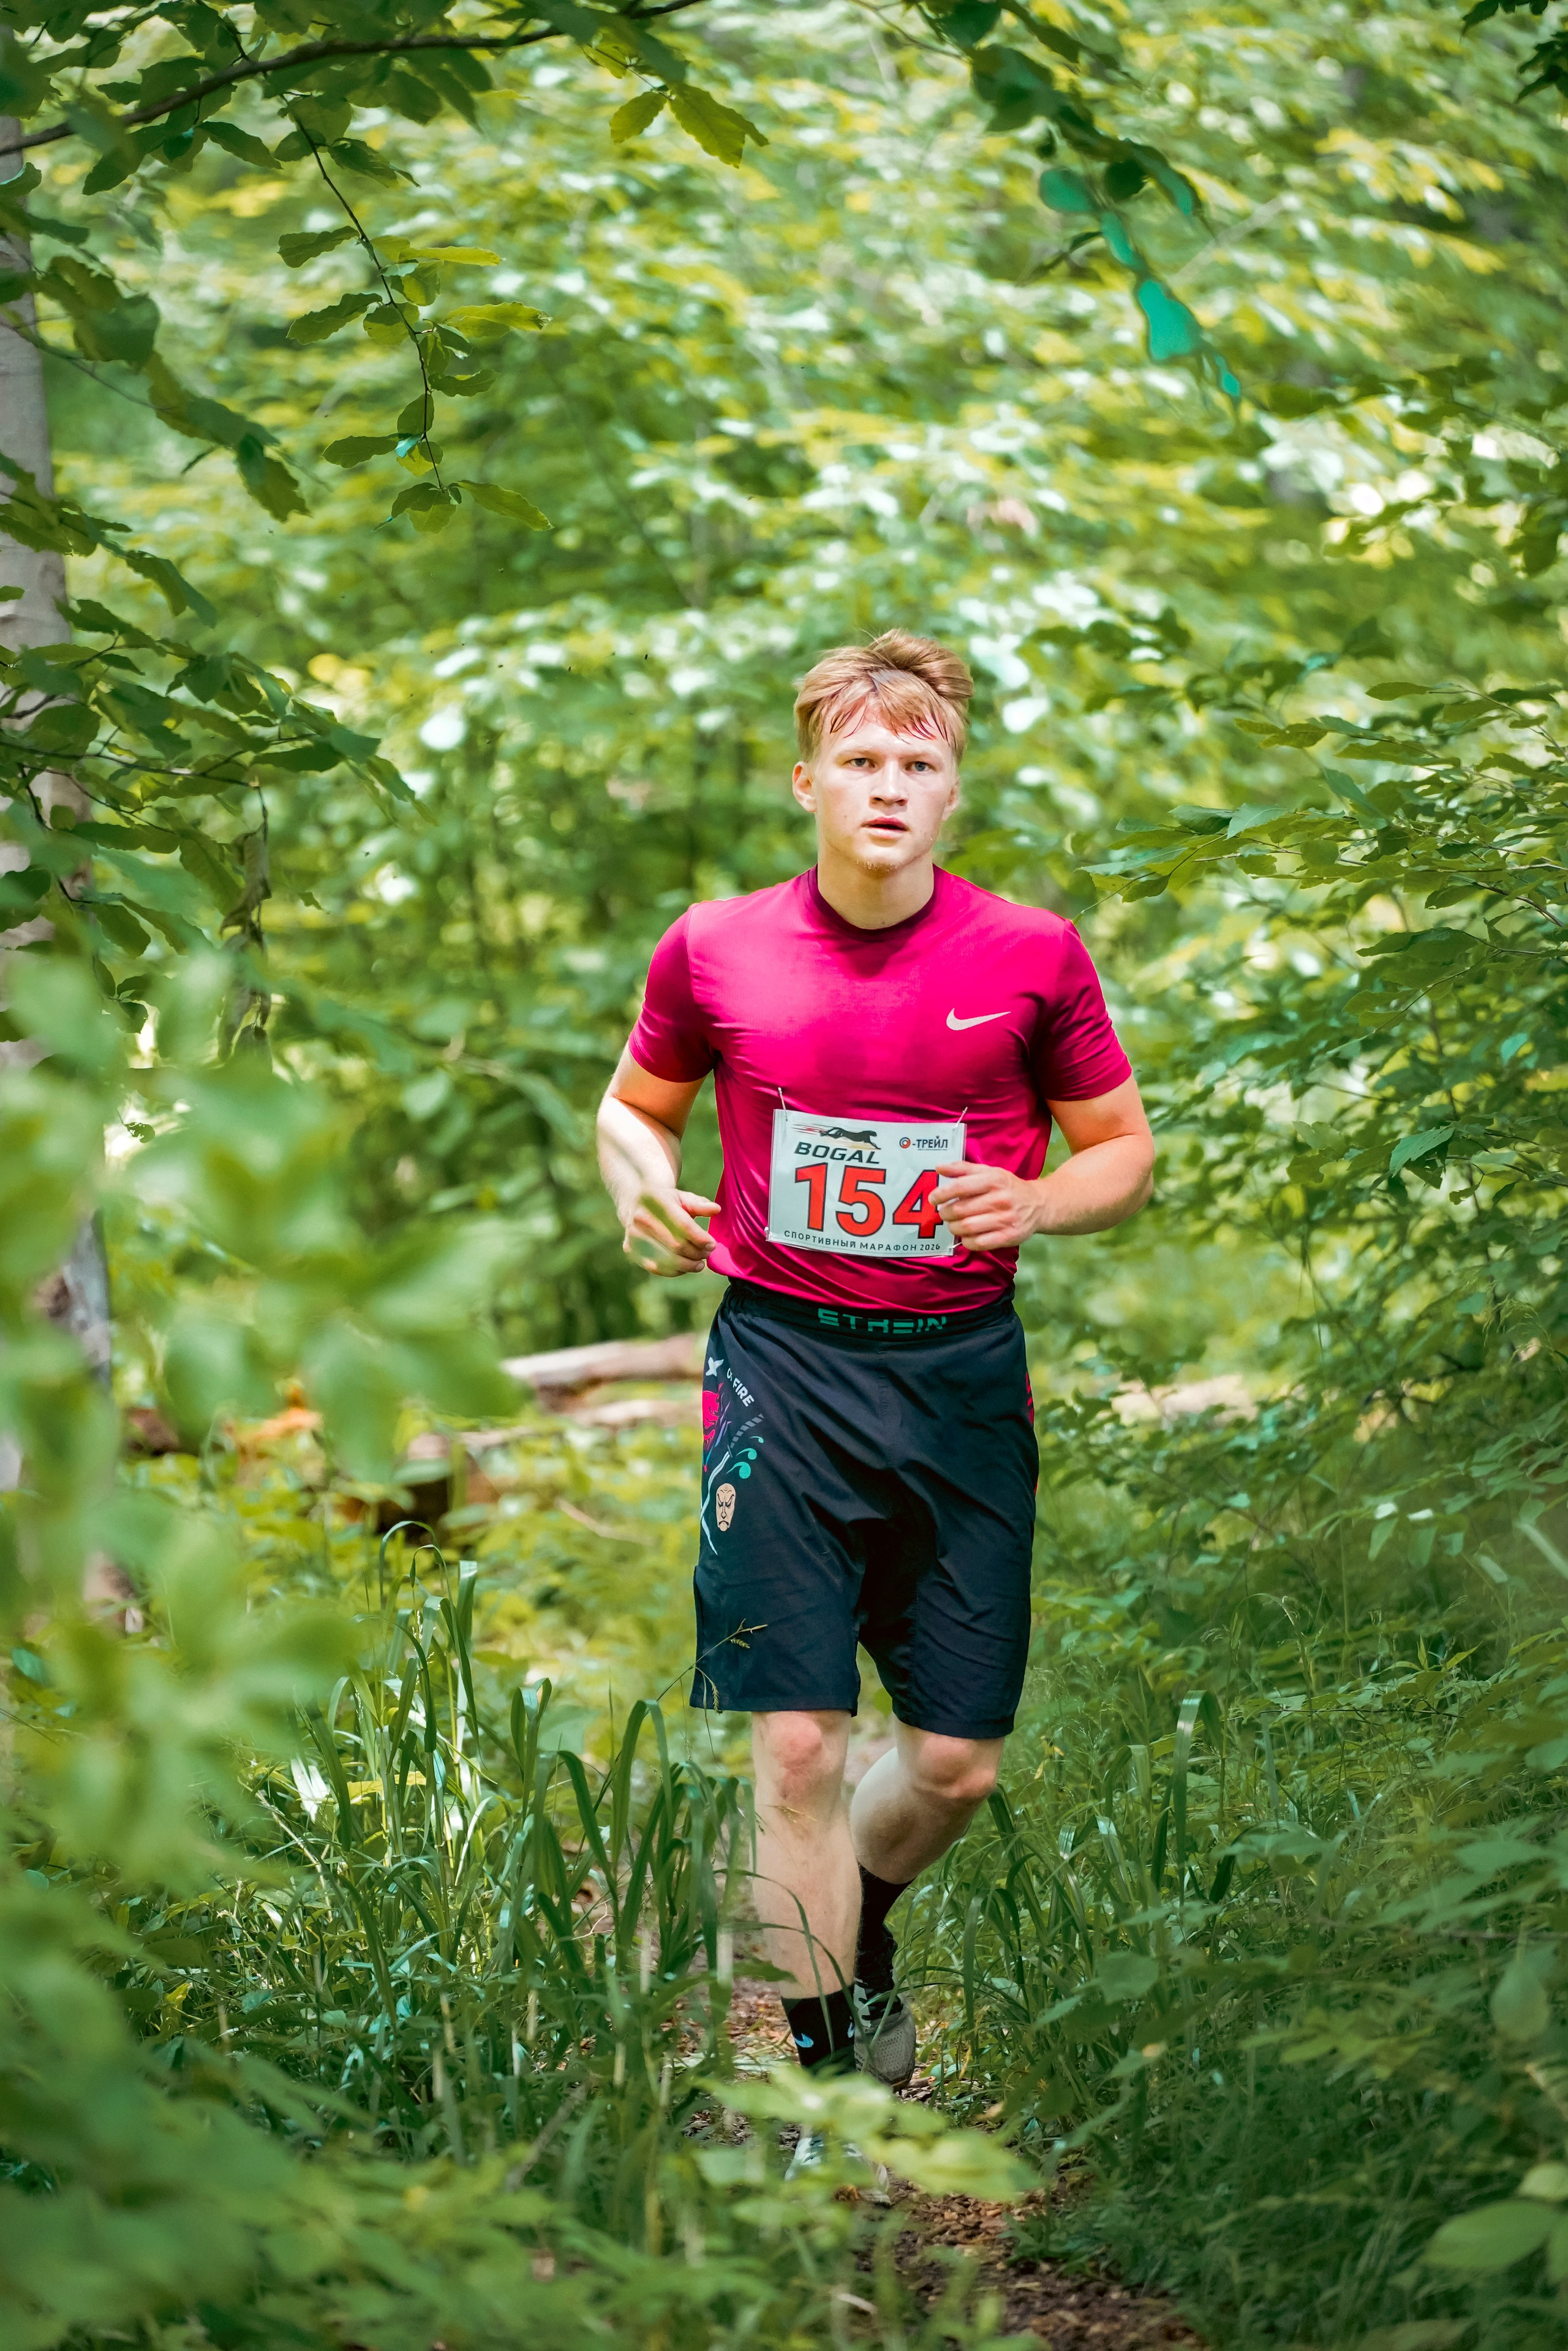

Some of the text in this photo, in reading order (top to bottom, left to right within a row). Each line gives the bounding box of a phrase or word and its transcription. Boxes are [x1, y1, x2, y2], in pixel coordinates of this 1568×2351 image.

[794, 1141, 880, 1164] BOGAL
[794, 1162, 944, 1239] 154
[784, 1230, 856, 1248] СПОРТИВНЫЙ
[859, 1242, 917, 1251] МАРАФОН
[733, 1377, 755, 1407] FIRE
